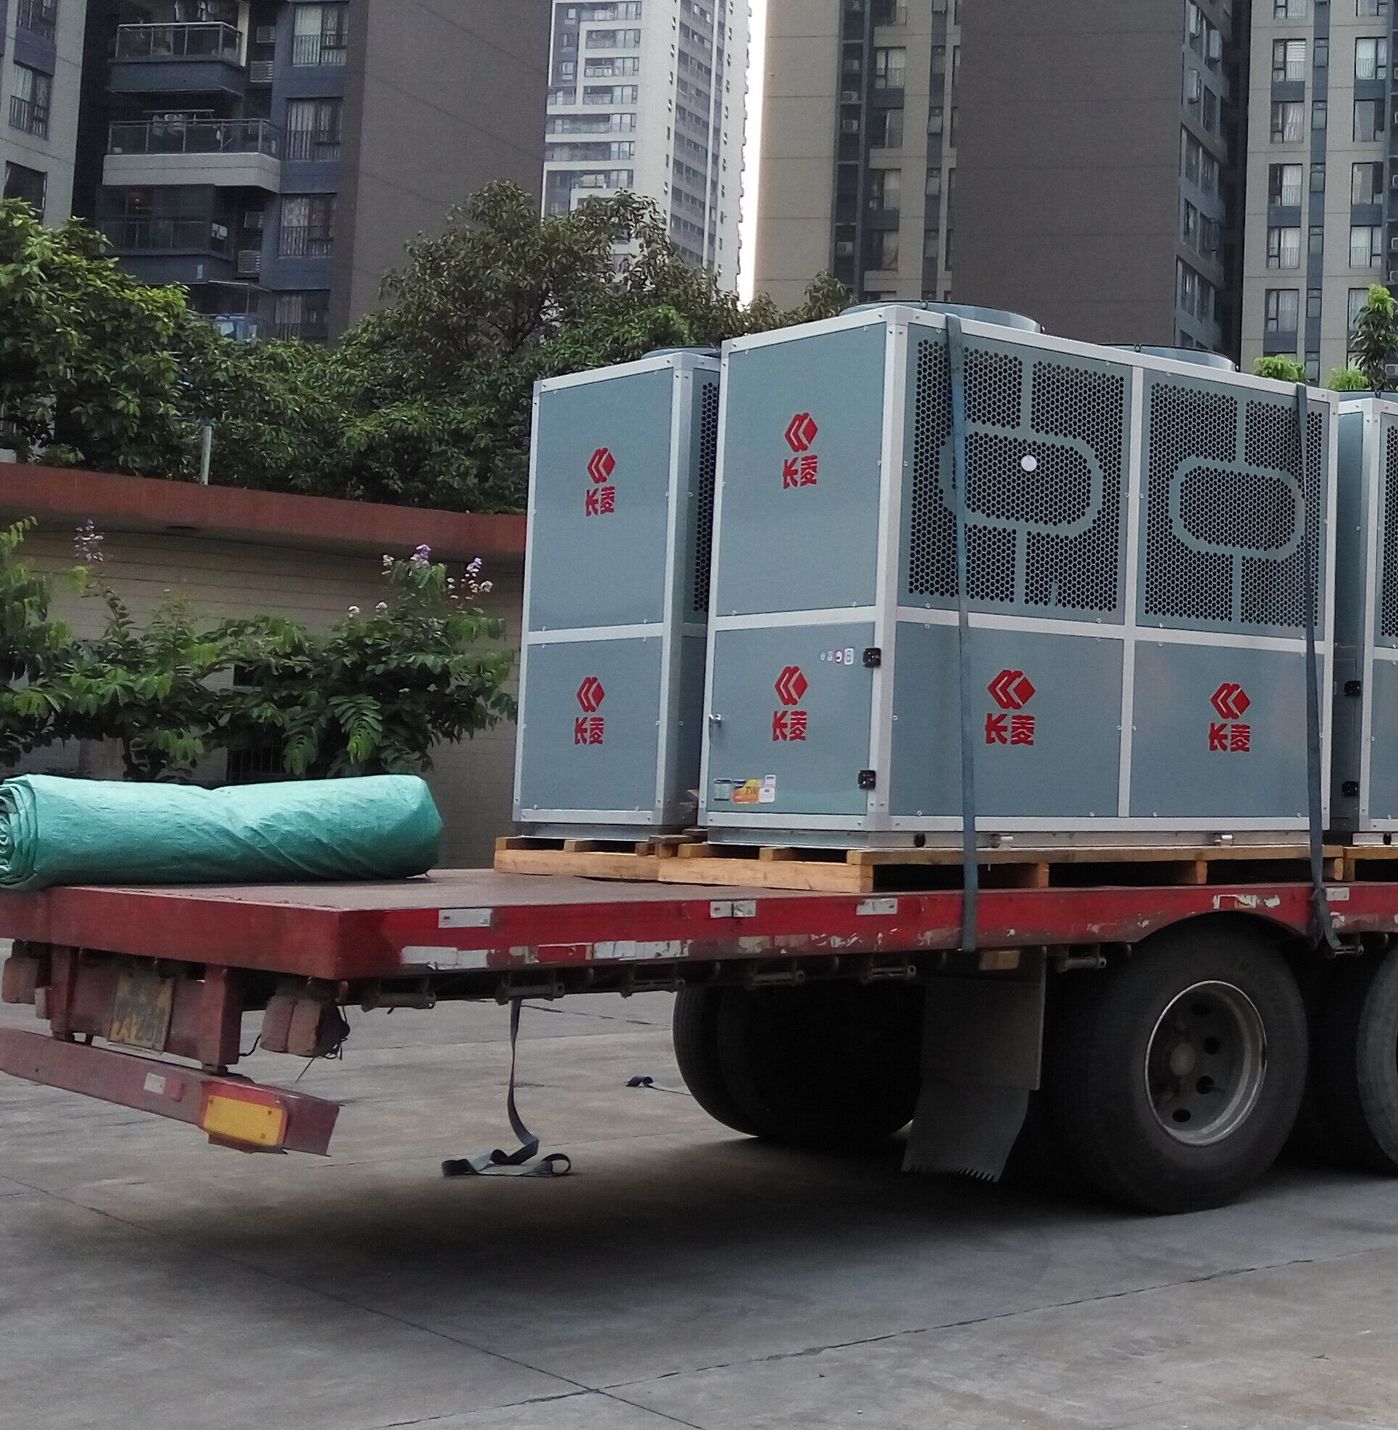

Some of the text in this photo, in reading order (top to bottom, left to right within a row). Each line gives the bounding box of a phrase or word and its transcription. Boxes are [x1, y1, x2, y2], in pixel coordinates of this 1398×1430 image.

[782, 455, 818, 488] 长菱
[585, 486, 615, 516] 长菱
[573, 717, 604, 746] 长菱
[772, 711, 807, 742] 长菱
[985, 714, 1034, 745] 长菱
[1209, 723, 1250, 753] 长菱
